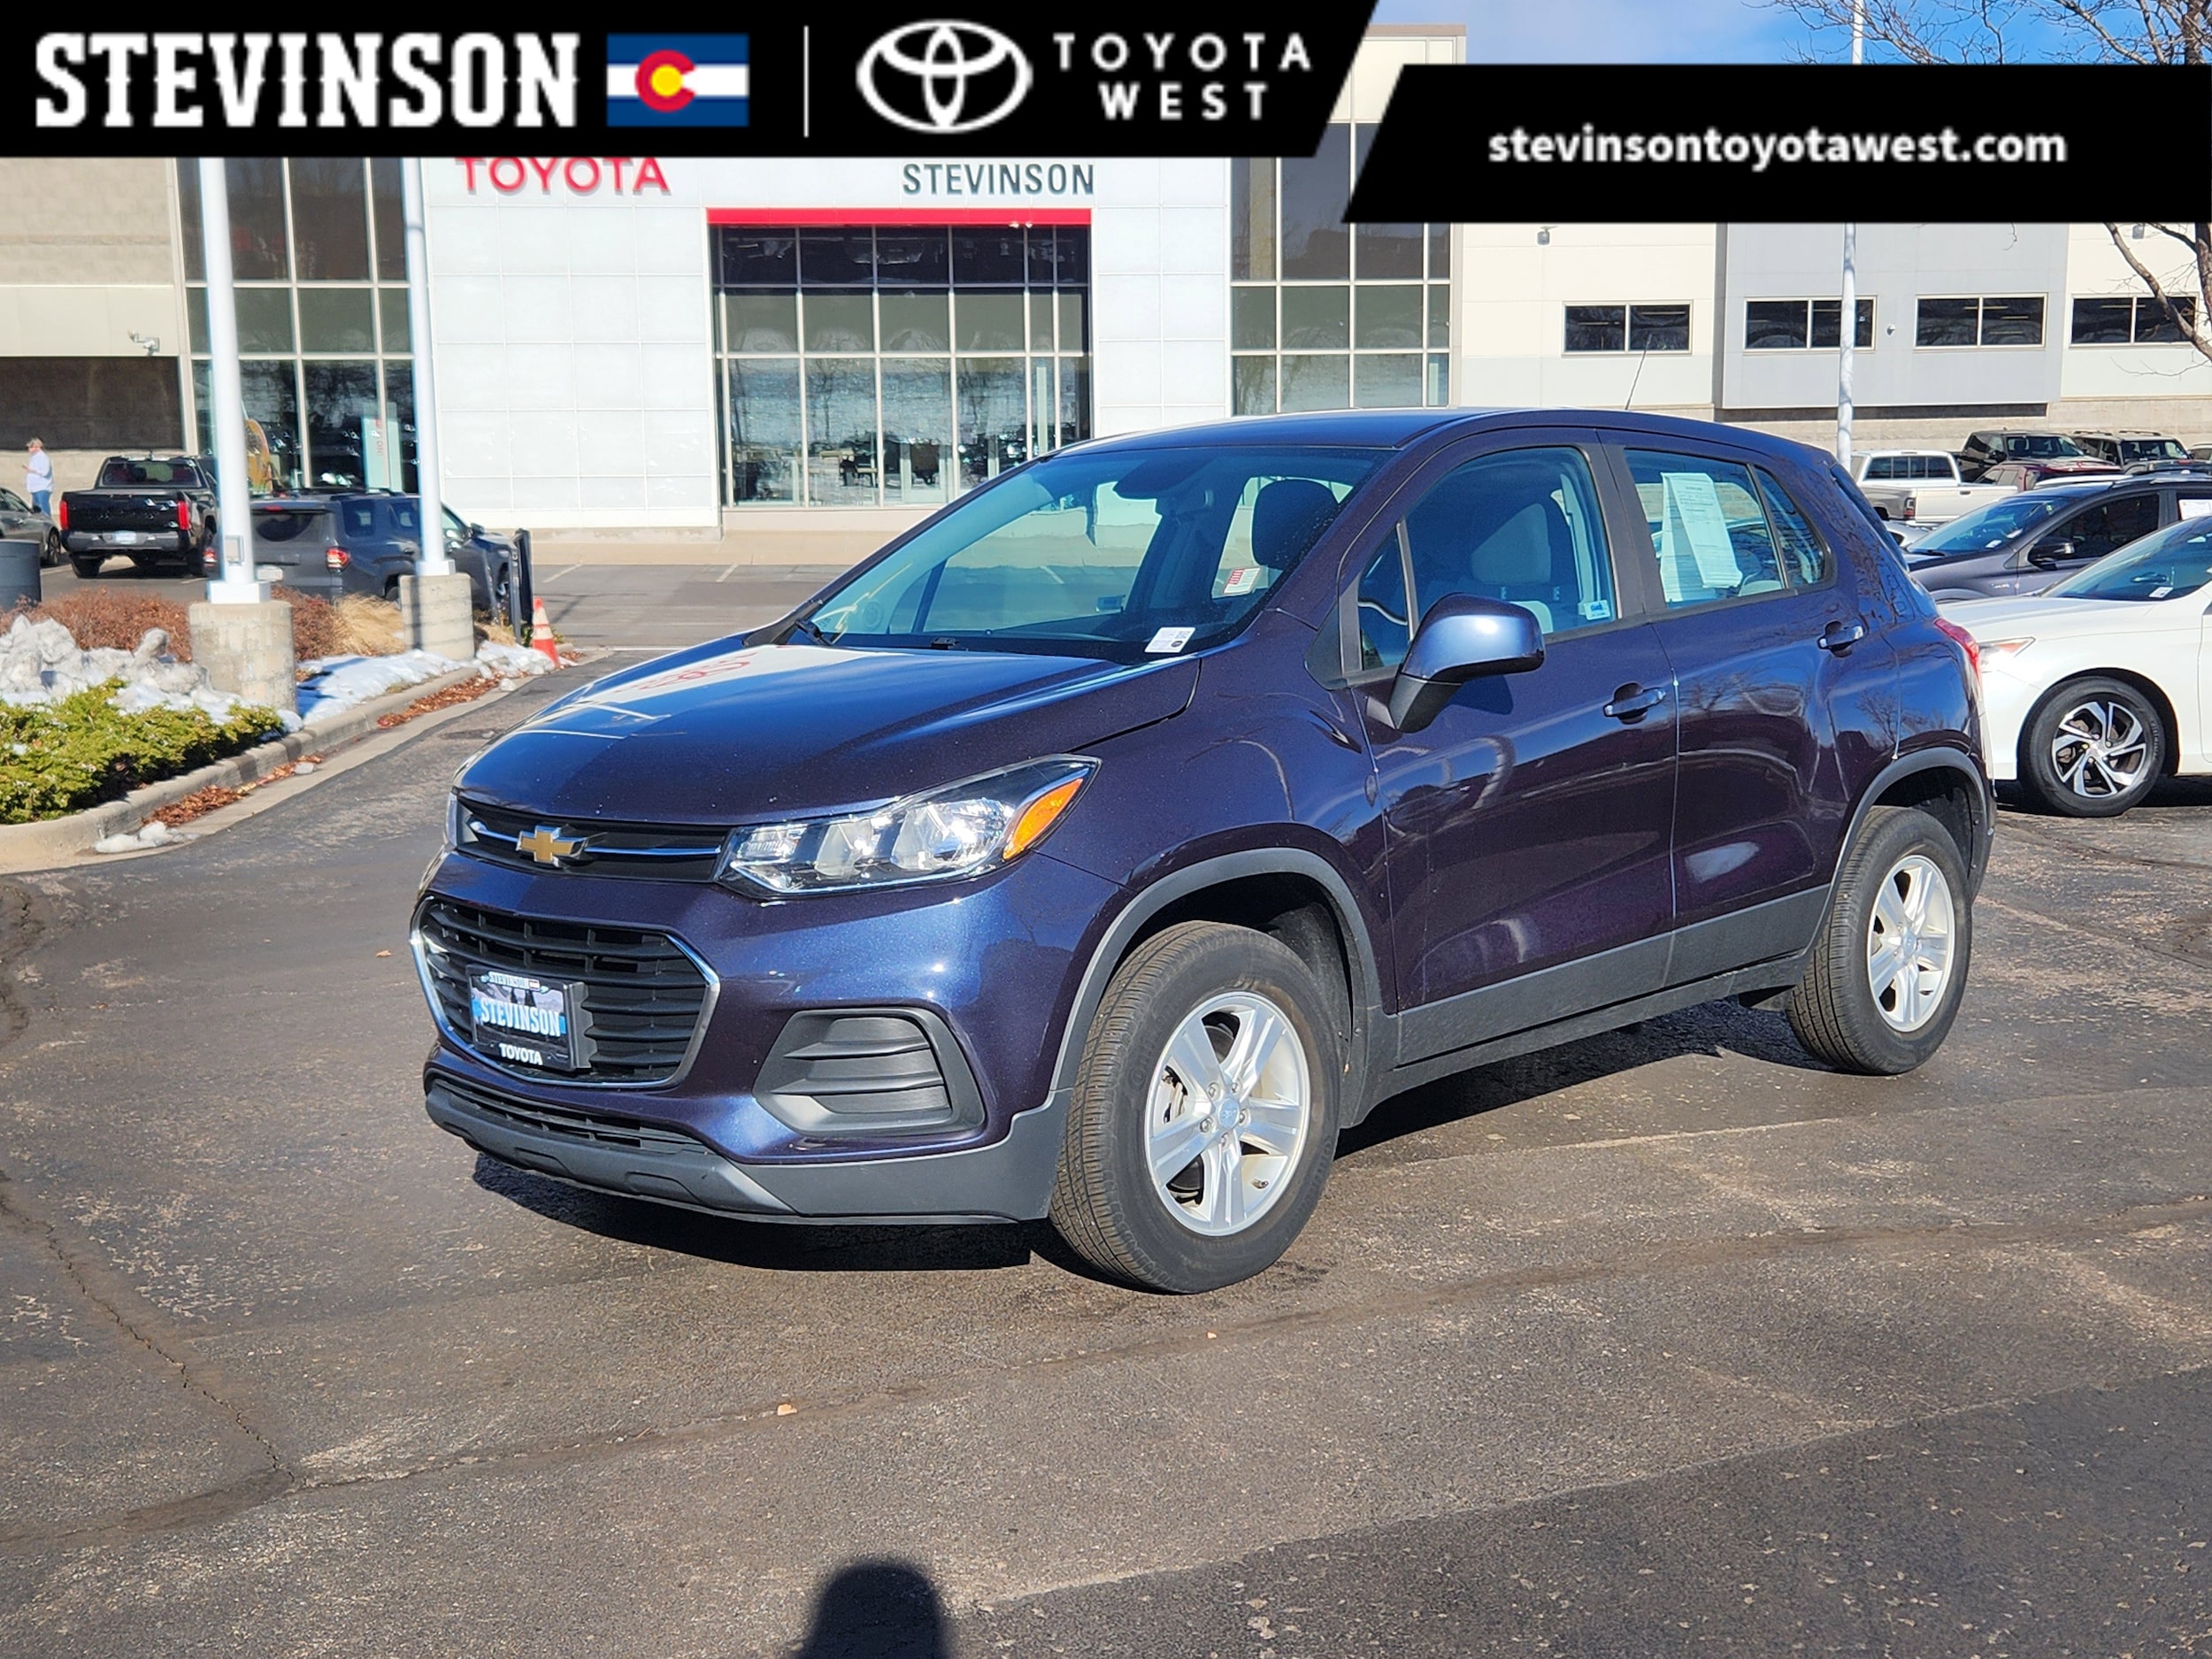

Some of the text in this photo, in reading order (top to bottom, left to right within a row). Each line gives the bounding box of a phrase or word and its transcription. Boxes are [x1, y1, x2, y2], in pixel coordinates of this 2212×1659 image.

[457, 157, 669, 193] TOYOTA
[903, 164, 1093, 194] STEVINSON
[480, 997, 560, 1036] STEVINSON
[498, 1042, 543, 1065] TOYOTA
